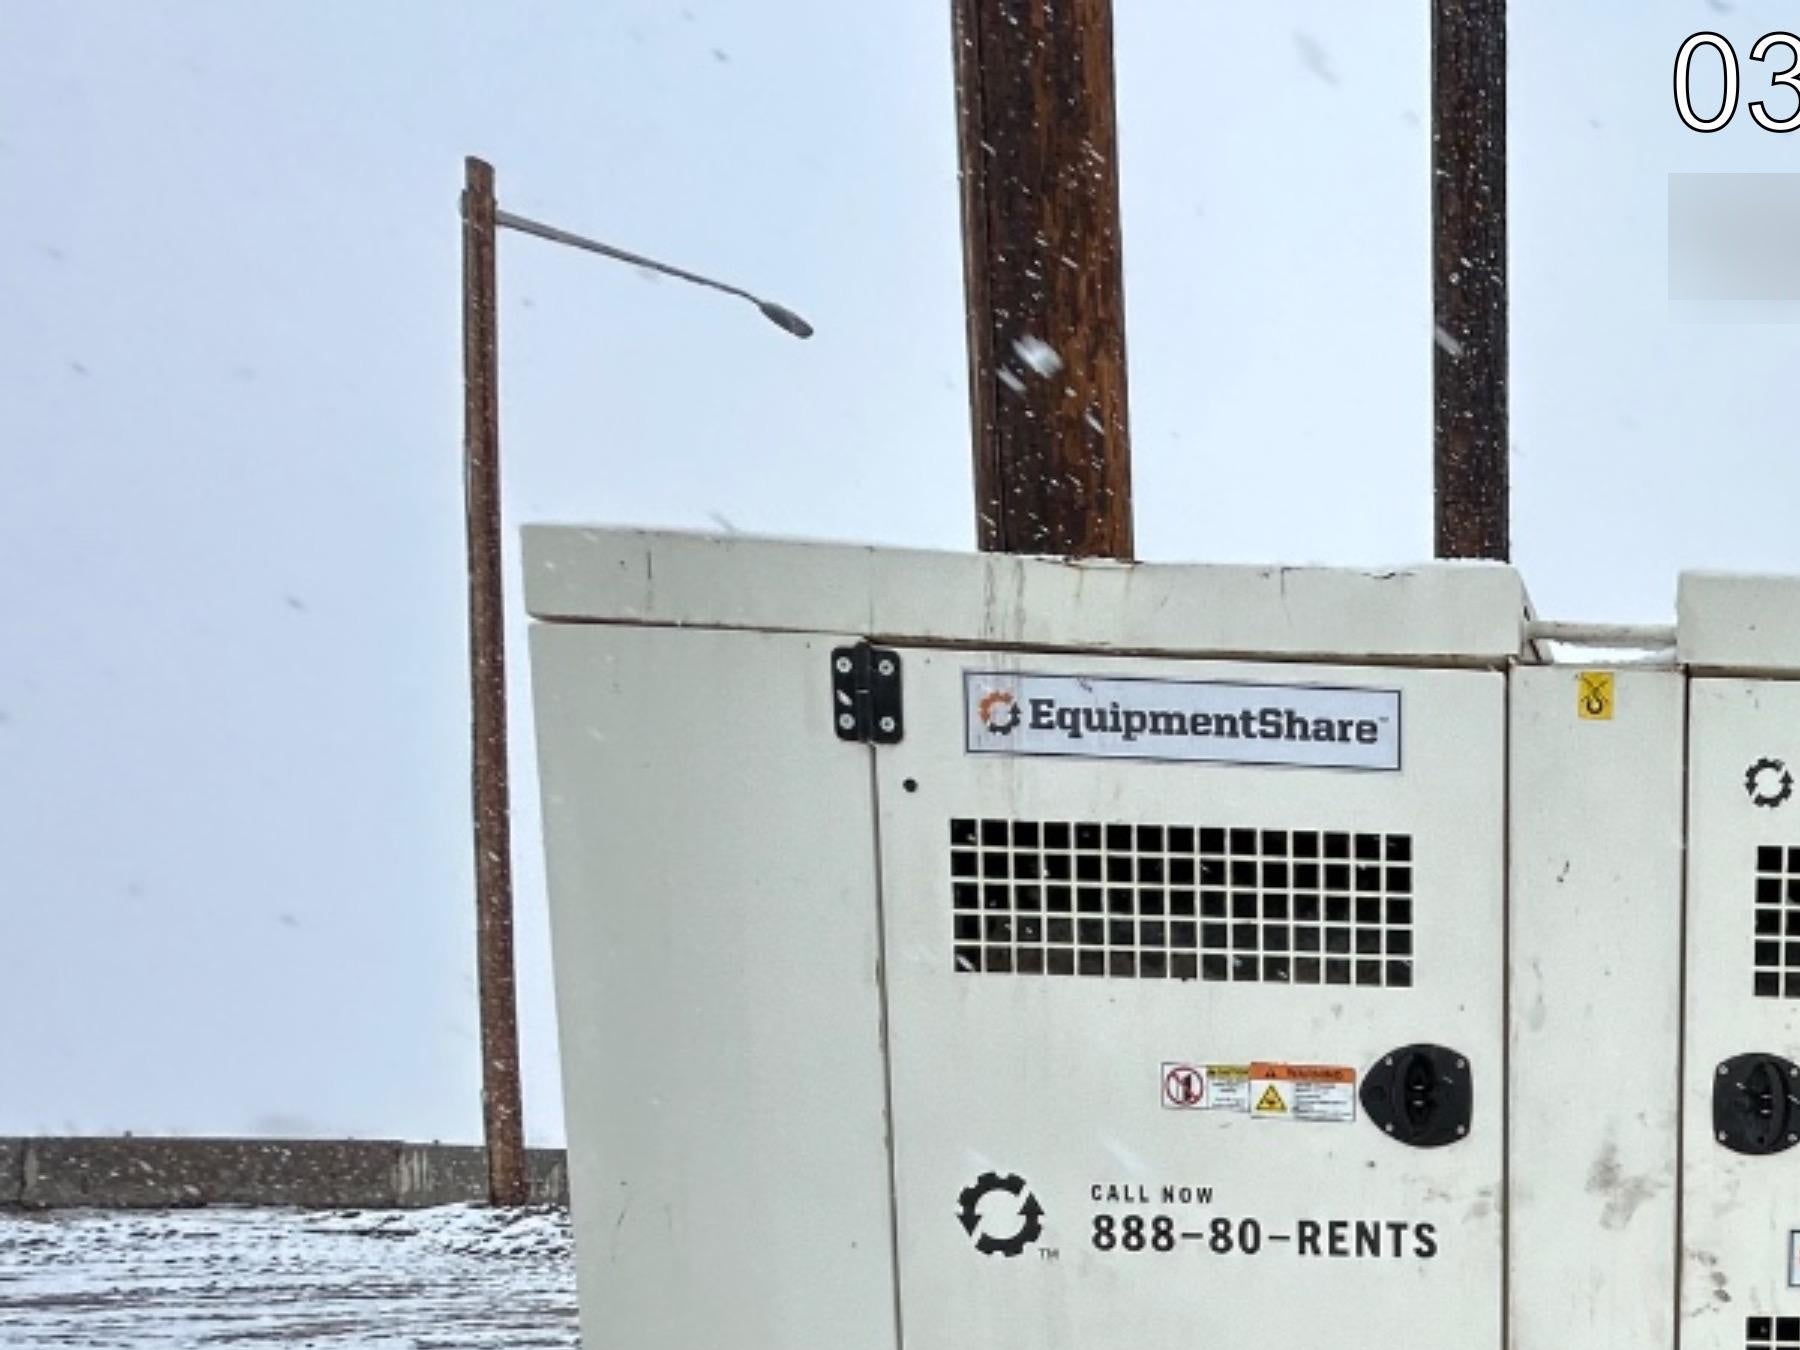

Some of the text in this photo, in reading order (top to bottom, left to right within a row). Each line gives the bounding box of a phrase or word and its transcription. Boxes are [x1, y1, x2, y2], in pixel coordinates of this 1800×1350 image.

[1028, 698, 1379, 745] EquipmentShare
[1091, 1184, 1213, 1205] CALL NOW
[1092, 1214, 1438, 1258] 888-80-RENTS
